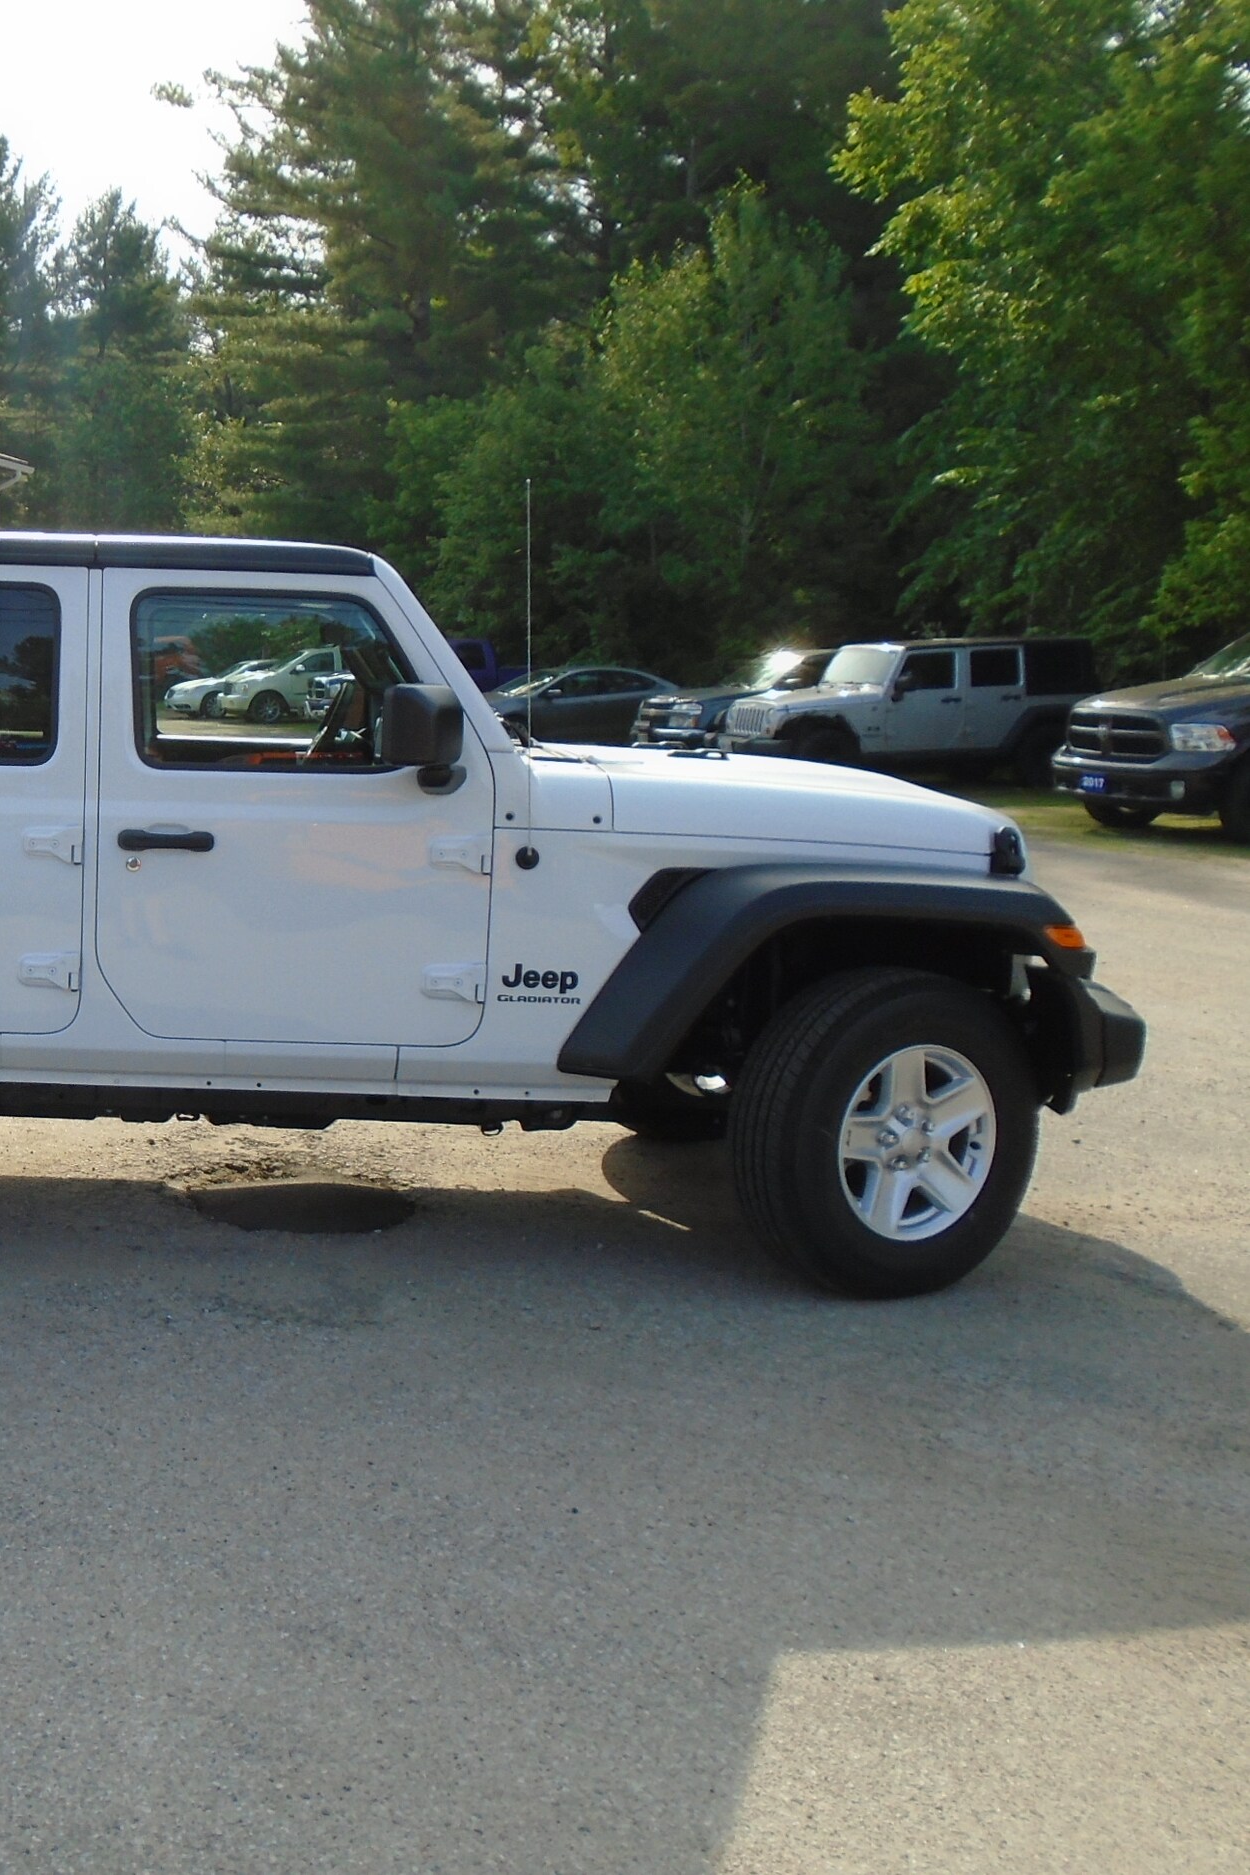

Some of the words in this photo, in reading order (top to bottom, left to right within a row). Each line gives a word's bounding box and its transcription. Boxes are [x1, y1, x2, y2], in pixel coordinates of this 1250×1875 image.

[1082, 776, 1105, 788] 2017
[502, 963, 579, 994] Jeep
[497, 994, 581, 1004] GLADIATOR
